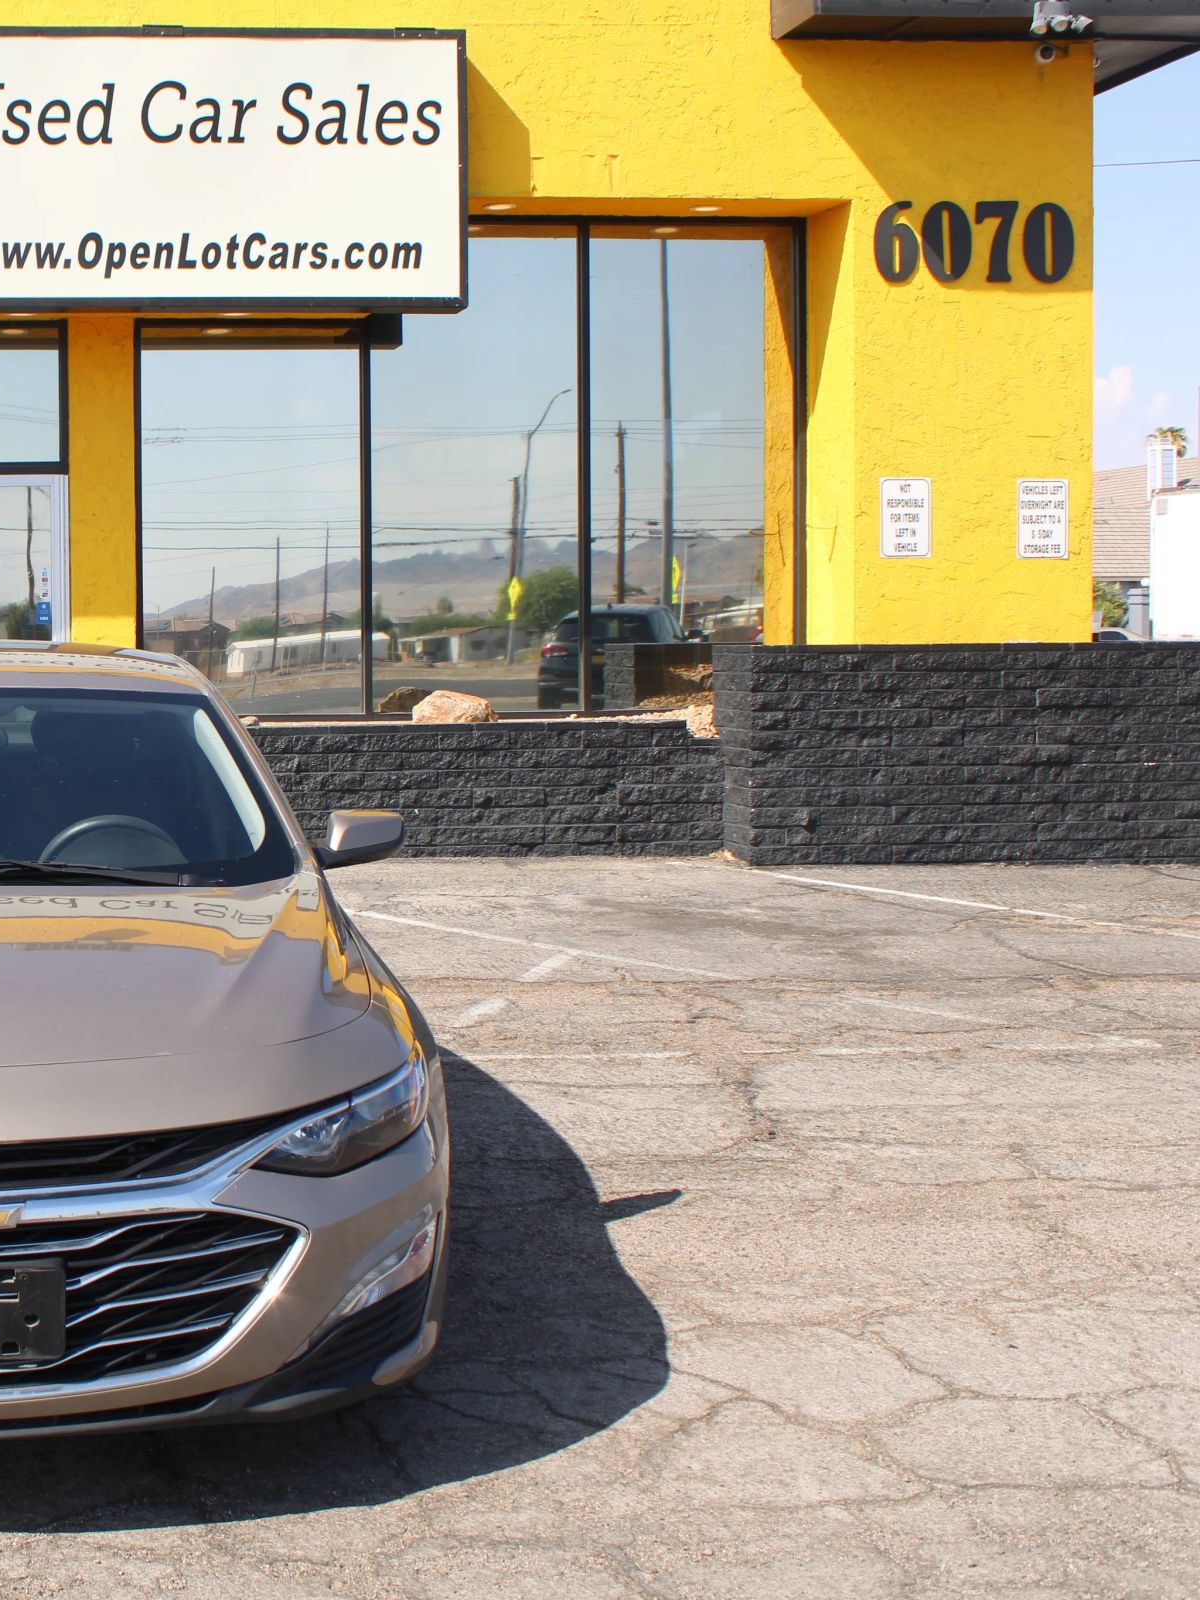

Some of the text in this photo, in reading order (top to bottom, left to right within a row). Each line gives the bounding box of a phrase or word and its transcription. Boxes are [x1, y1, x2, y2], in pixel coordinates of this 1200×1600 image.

[141, 80, 257, 144] Car
[276, 82, 442, 146] Sales
[874, 200, 1075, 284] 6070
[899, 483, 912, 494] NOT
[1021, 485, 1064, 496] VEHICLES LEFT
[886, 498, 925, 509] RESPONSIBLE
[1020, 500, 1065, 510] OVERNIGHT ARE
[890, 513, 920, 523] FOR ITEMS
[1021, 514, 1062, 525] SUBJECT TO A
[895, 527, 916, 538] LEFT IN
[894, 542, 918, 553] VEHICLE
[1022, 544, 1062, 554] STORAGE FEE
